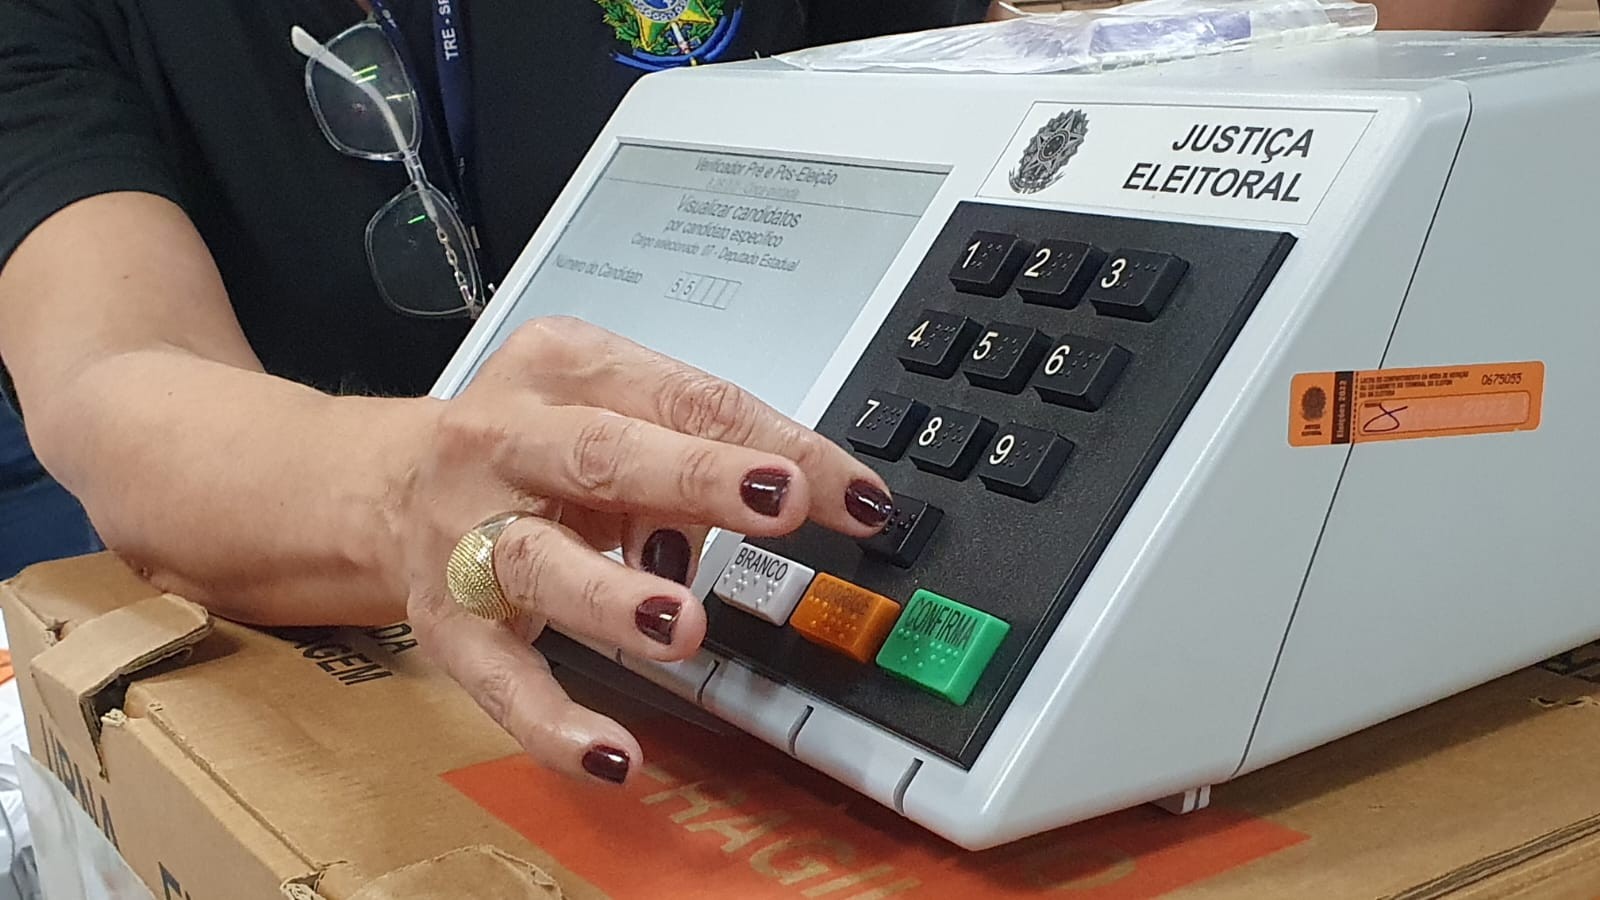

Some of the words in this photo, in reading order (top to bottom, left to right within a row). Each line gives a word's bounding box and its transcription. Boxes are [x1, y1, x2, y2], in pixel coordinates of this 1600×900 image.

[441, 28, 459, 61] TRE
[1172, 124, 1314, 164] JUSTIÇA
[1122, 162, 1302, 202] ELEITORAL
[677, 194, 733, 218] Visualizar
[731, 205, 802, 229] candidatos
[663, 219, 685, 233] por
[682, 221, 730, 240] candidato
[597, 261, 644, 284] Candidato
[718, 246, 760, 264] Deputado
[758, 253, 801, 272] Estadual
[963, 240, 981, 269] 1
[1024, 248, 1051, 277] 2
[1101, 258, 1127, 289] 3
[907, 320, 930, 348] 4
[973, 331, 999, 360] 5
[1044, 345, 1071, 375] 6
[1481, 372, 1523, 386] 0675055
[855, 399, 880, 427] 7
[918, 416, 943, 446] 8
[989, 434, 1015, 465] 9
[734, 547, 789, 582] BRANCO
[904, 597, 979, 650] CONFIRMA
